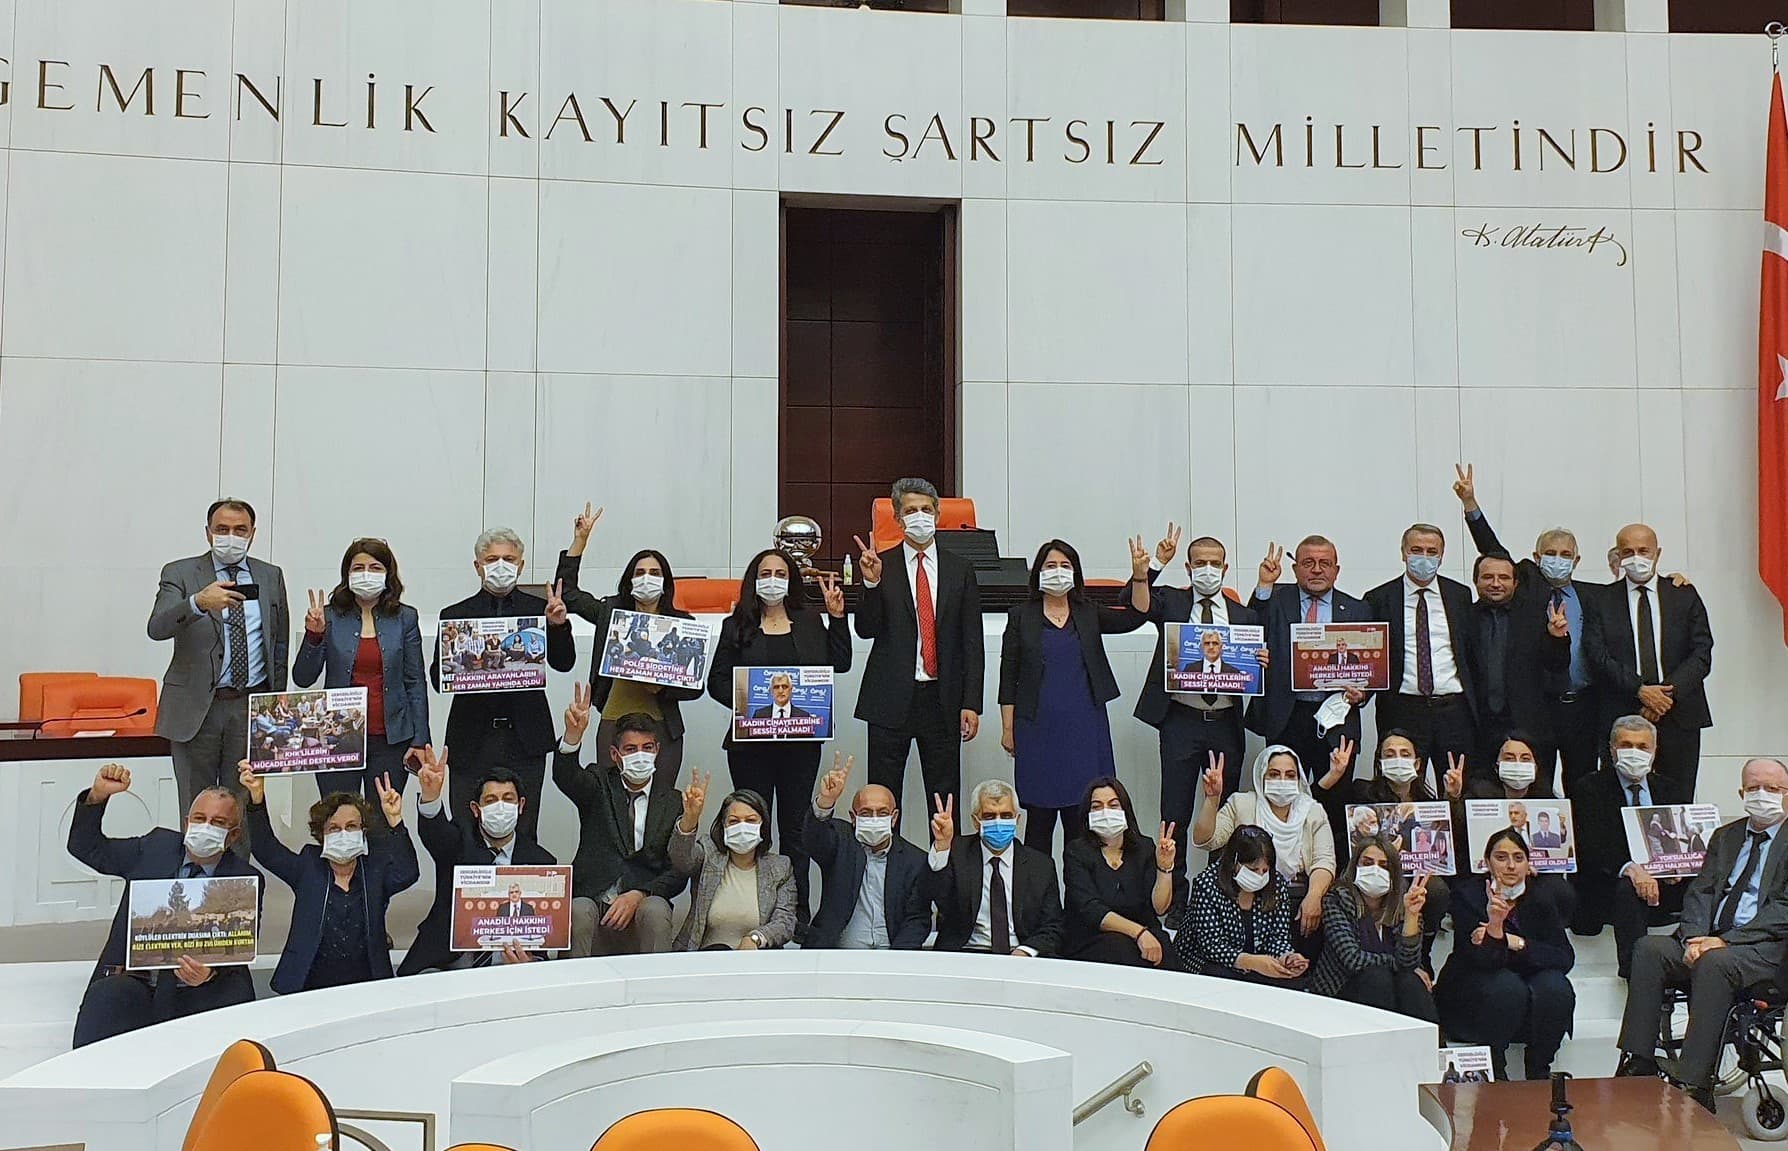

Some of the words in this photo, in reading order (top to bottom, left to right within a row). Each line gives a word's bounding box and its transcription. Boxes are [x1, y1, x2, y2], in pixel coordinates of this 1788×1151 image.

[0, 57, 438, 134] EMENLİK
[498, 90, 846, 156] KAYITSIZ
[882, 111, 1166, 167] ŞARTSIZ
[1236, 115, 1710, 174] MİLLETİNDİR
[1500, 223, 1627, 267] Atatürk
[609, 666, 626, 674] HER
[626, 668, 654, 676] ZAMAN
[1208, 681, 1241, 689] KALMADI
[742, 719, 766, 727] KADIN
[766, 717, 821, 727] CİNAYETLERİNE
[752, 726, 778, 735] SESSİZ
[778, 726, 811, 734] KALMADI
[308, 755, 336, 766] DESTEK
[337, 752, 360, 763] VERDİ
[477, 917, 511, 926] ANADİLİ
[511, 917, 546, 925] HAKKINI
[473, 927, 506, 936] HERKES
[506, 926, 524, 936] İÇİN
[524, 925, 550, 934] İSTEDİ
